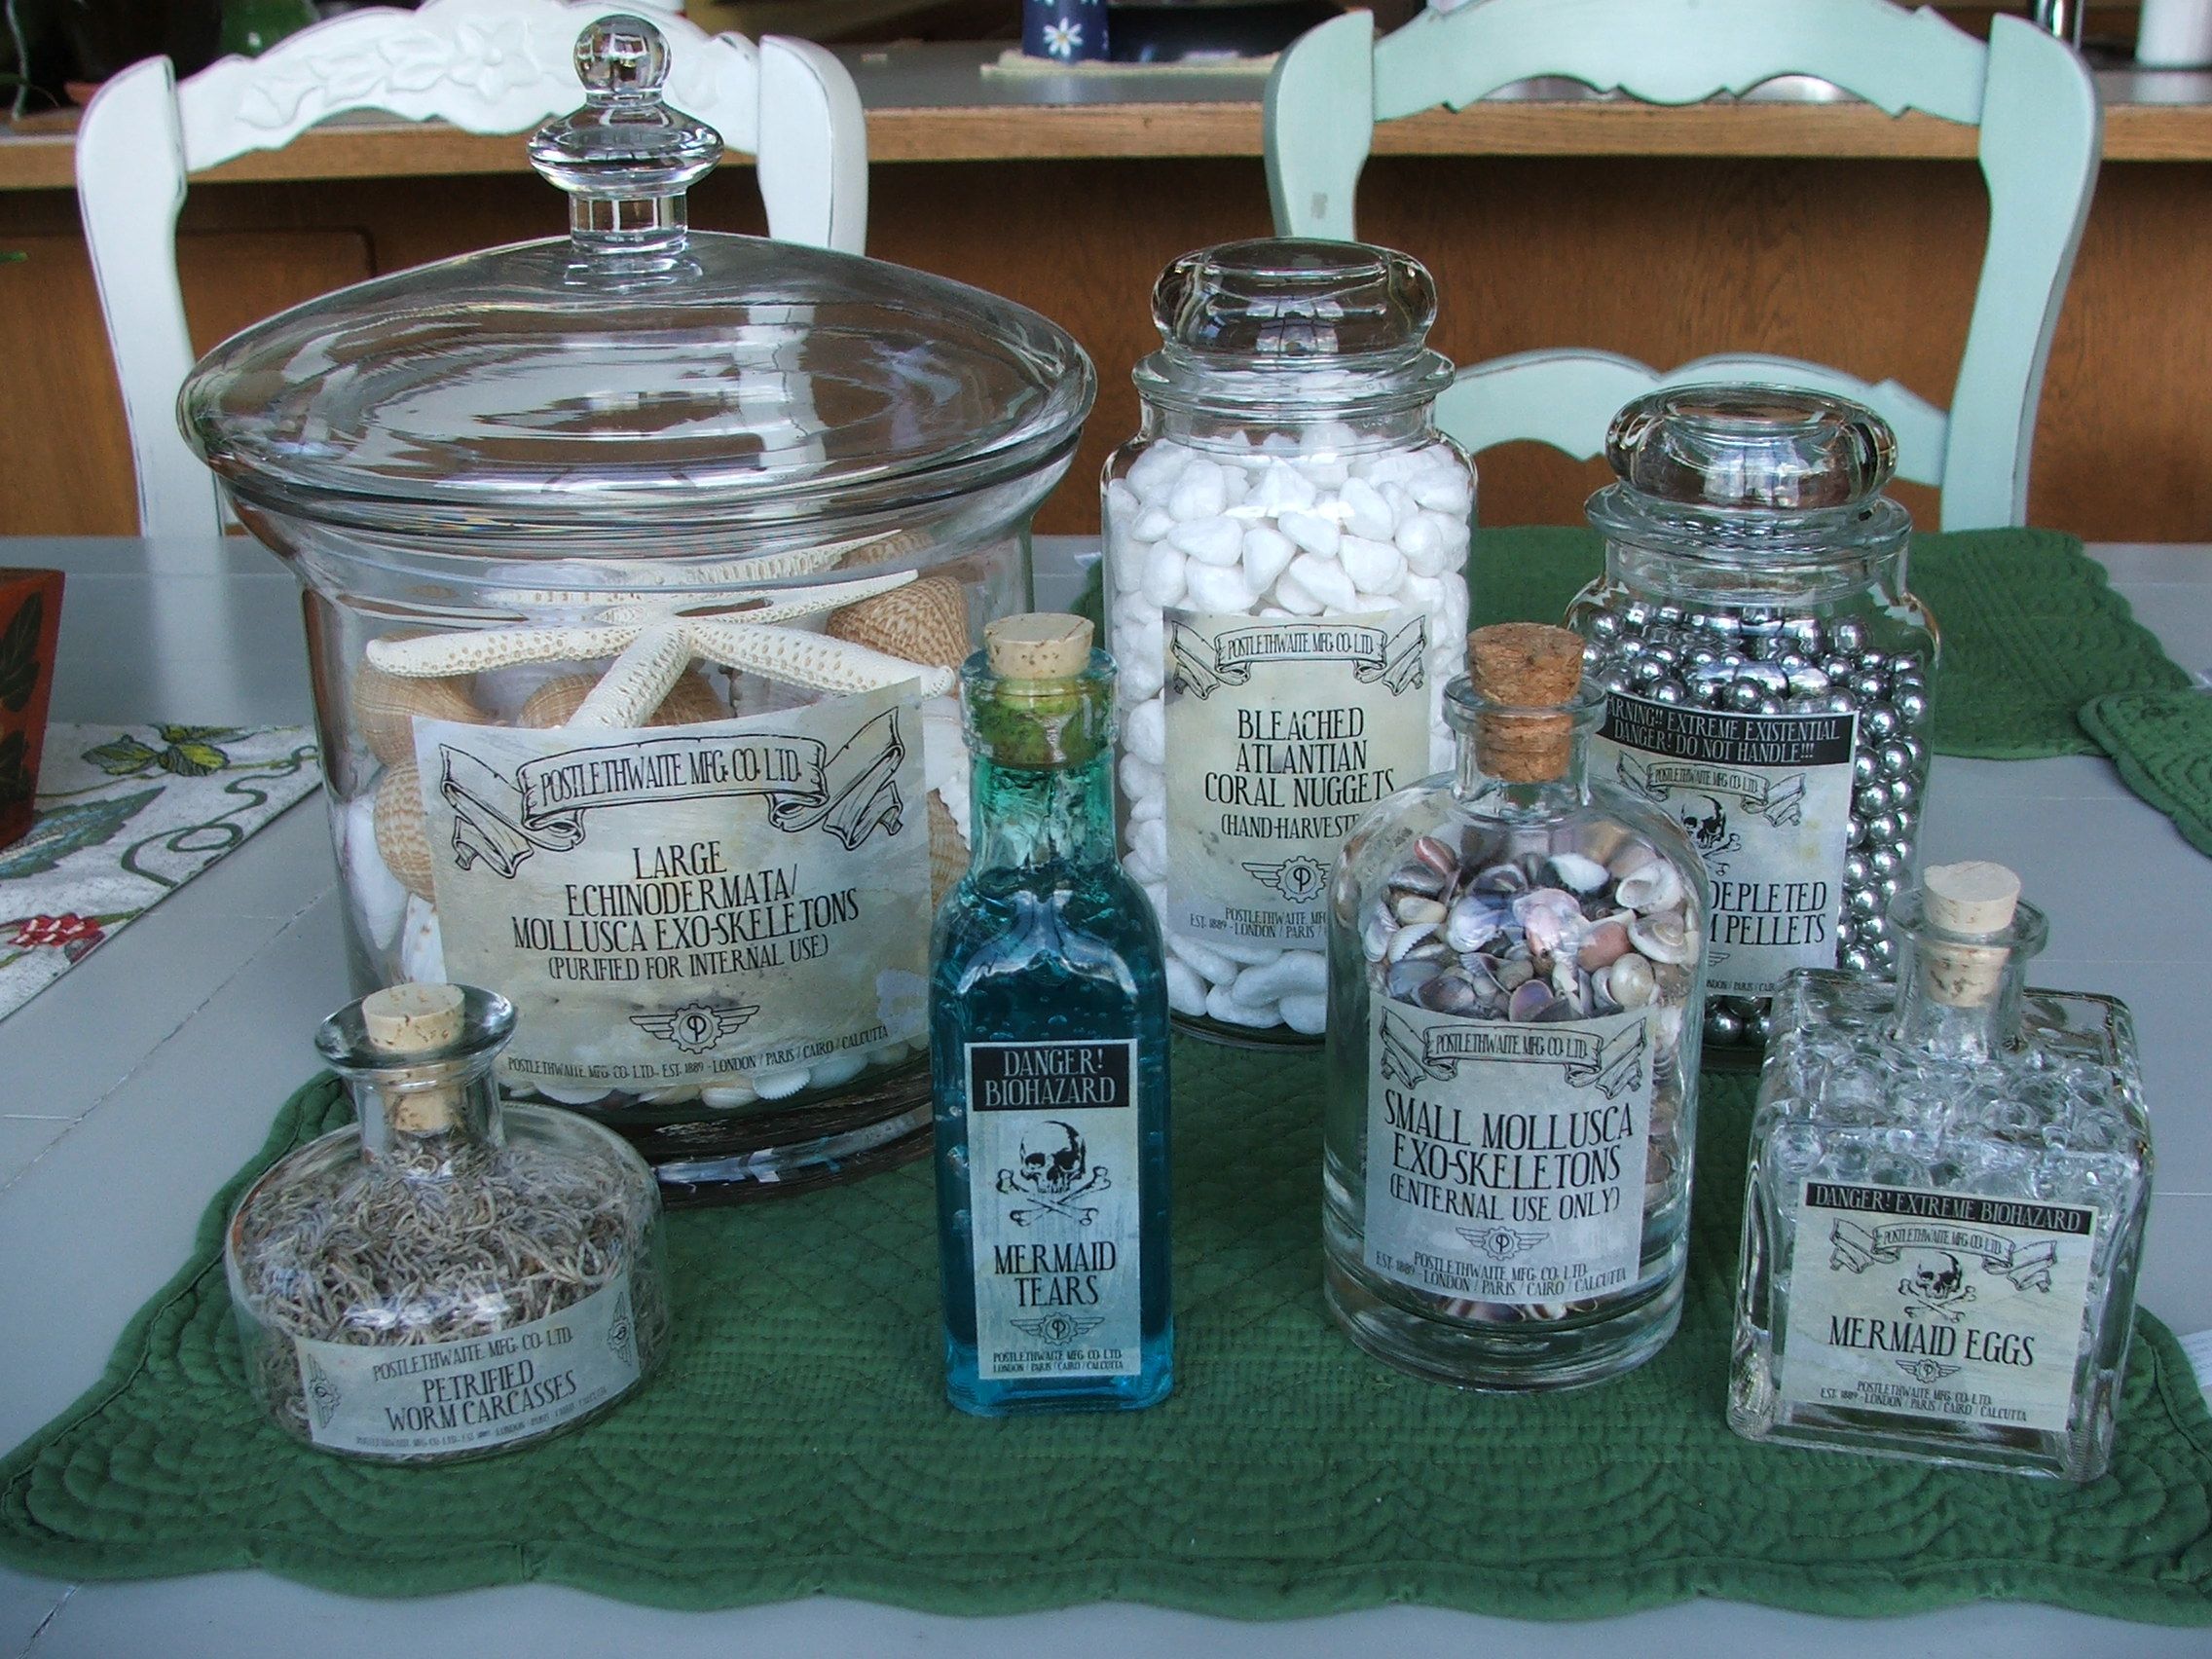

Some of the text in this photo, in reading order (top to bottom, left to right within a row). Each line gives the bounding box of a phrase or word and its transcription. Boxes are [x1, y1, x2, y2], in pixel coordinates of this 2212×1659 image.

[1228, 633, 1310, 660] POSTLETHWAITE
[1237, 707, 1364, 741] BLEACHED
[1607, 696, 1840, 742] ARNING!! EXTREME EXISTENTIAL
[1235, 740, 1368, 774] ATLANTIAN
[1614, 719, 1815, 763] DANGER! DO NOT HANDLE!!!
[540, 753, 688, 807] POSTLETHWAITE
[1204, 768, 1394, 807] CORAL NUGGETS
[632, 840, 727, 880] LARGE
[511, 888, 861, 953] MOLLUSCA EXO-SKELETONS
[1725, 913, 1826, 945] PELLETS
[548, 957, 640, 983] (PURIFIED
[645, 955, 684, 979] FOR
[687, 942, 785, 977] INTERNAL
[765, 1049, 795, 1066] PARIS
[802, 1040, 834, 1059] CAIRO
[841, 1025, 889, 1050] CALCUTTA
[1004, 1049, 1104, 1078] DANGER!
[984, 1077, 1116, 1107] BIOHAZARD
[1384, 1088, 1634, 1151] SMALL MOLLUSCA
[1393, 1131, 1621, 1190] EXO-SKELETONS
[1513, 1196, 1551, 1222] USE
[1560, 1187, 1621, 1221] ONLY)
[1816, 1186, 2081, 1232] DANGER! EXTREME BIOHAZARD
[994, 1240, 1117, 1274] MERMAID
[1014, 1274, 1099, 1307] TEARS
[1482, 1280, 1516, 1296] PARIS
[1527, 1281, 1565, 1296] CAIRO
[1574, 1267, 1626, 1292] CALCUTTA
[1828, 1315, 2036, 1367] MERMAID EGGS
[373, 1343, 484, 1382] POSTLETHWAITE
[423, 1359, 534, 1404] PETRIFIED
[386, 1403, 457, 1432] WORM
[463, 1370, 576, 1425] CARCASSES
